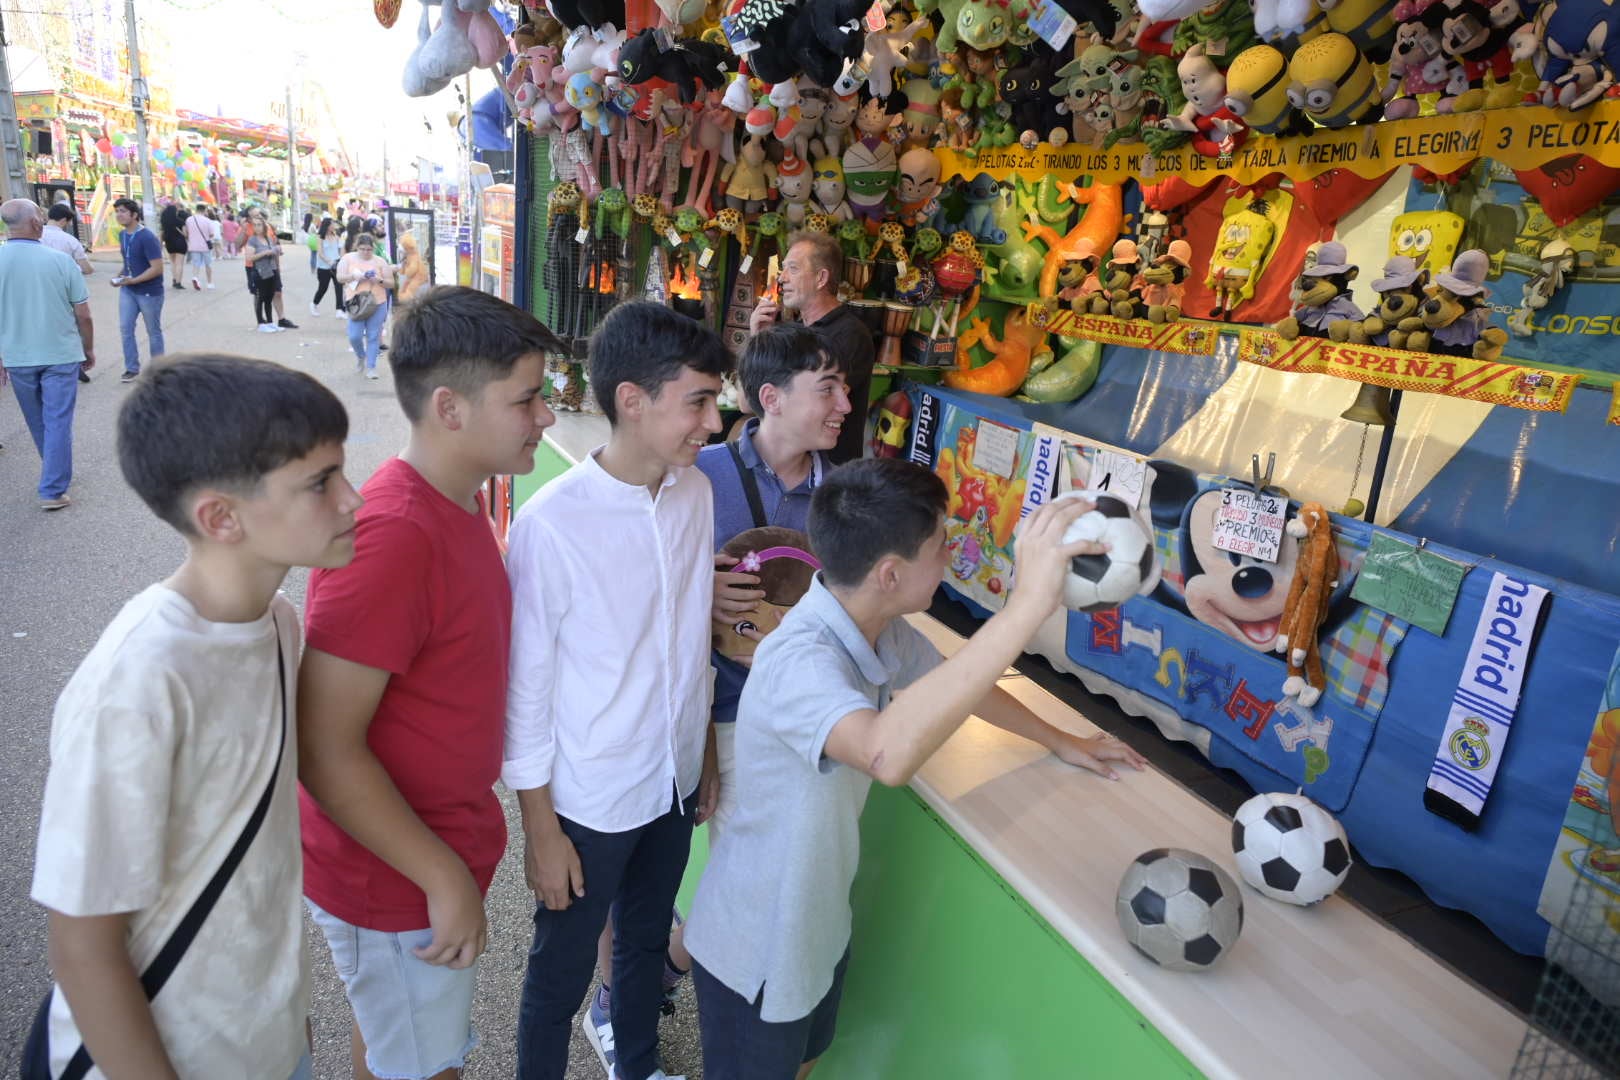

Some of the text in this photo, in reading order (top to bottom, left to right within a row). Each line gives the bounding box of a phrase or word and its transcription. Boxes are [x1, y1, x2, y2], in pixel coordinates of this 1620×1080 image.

[1496, 126, 1513, 149] 3
[1043, 154, 1082, 170] TIRANDO
[1087, 155, 1108, 170] LOS
[1113, 155, 1121, 171] 3
[1127, 154, 1182, 171] MUCOS
[1190, 154, 1207, 171] DE
[1242, 148, 1287, 168] TABLA
[1297, 141, 1358, 165] PREMIO
[1369, 140, 1381, 159] A
[1395, 130, 1461, 158] ELEGIR
[1073, 315, 1153, 339] ESPAÑA
[1319, 345, 1457, 380] ESPAÑA
[1222, 490, 1232, 505] 3
[1249, 512, 1258, 525] 3
[1225, 520, 1268, 544] PREMIO
[1229, 538, 1256, 555] ELEGIR
